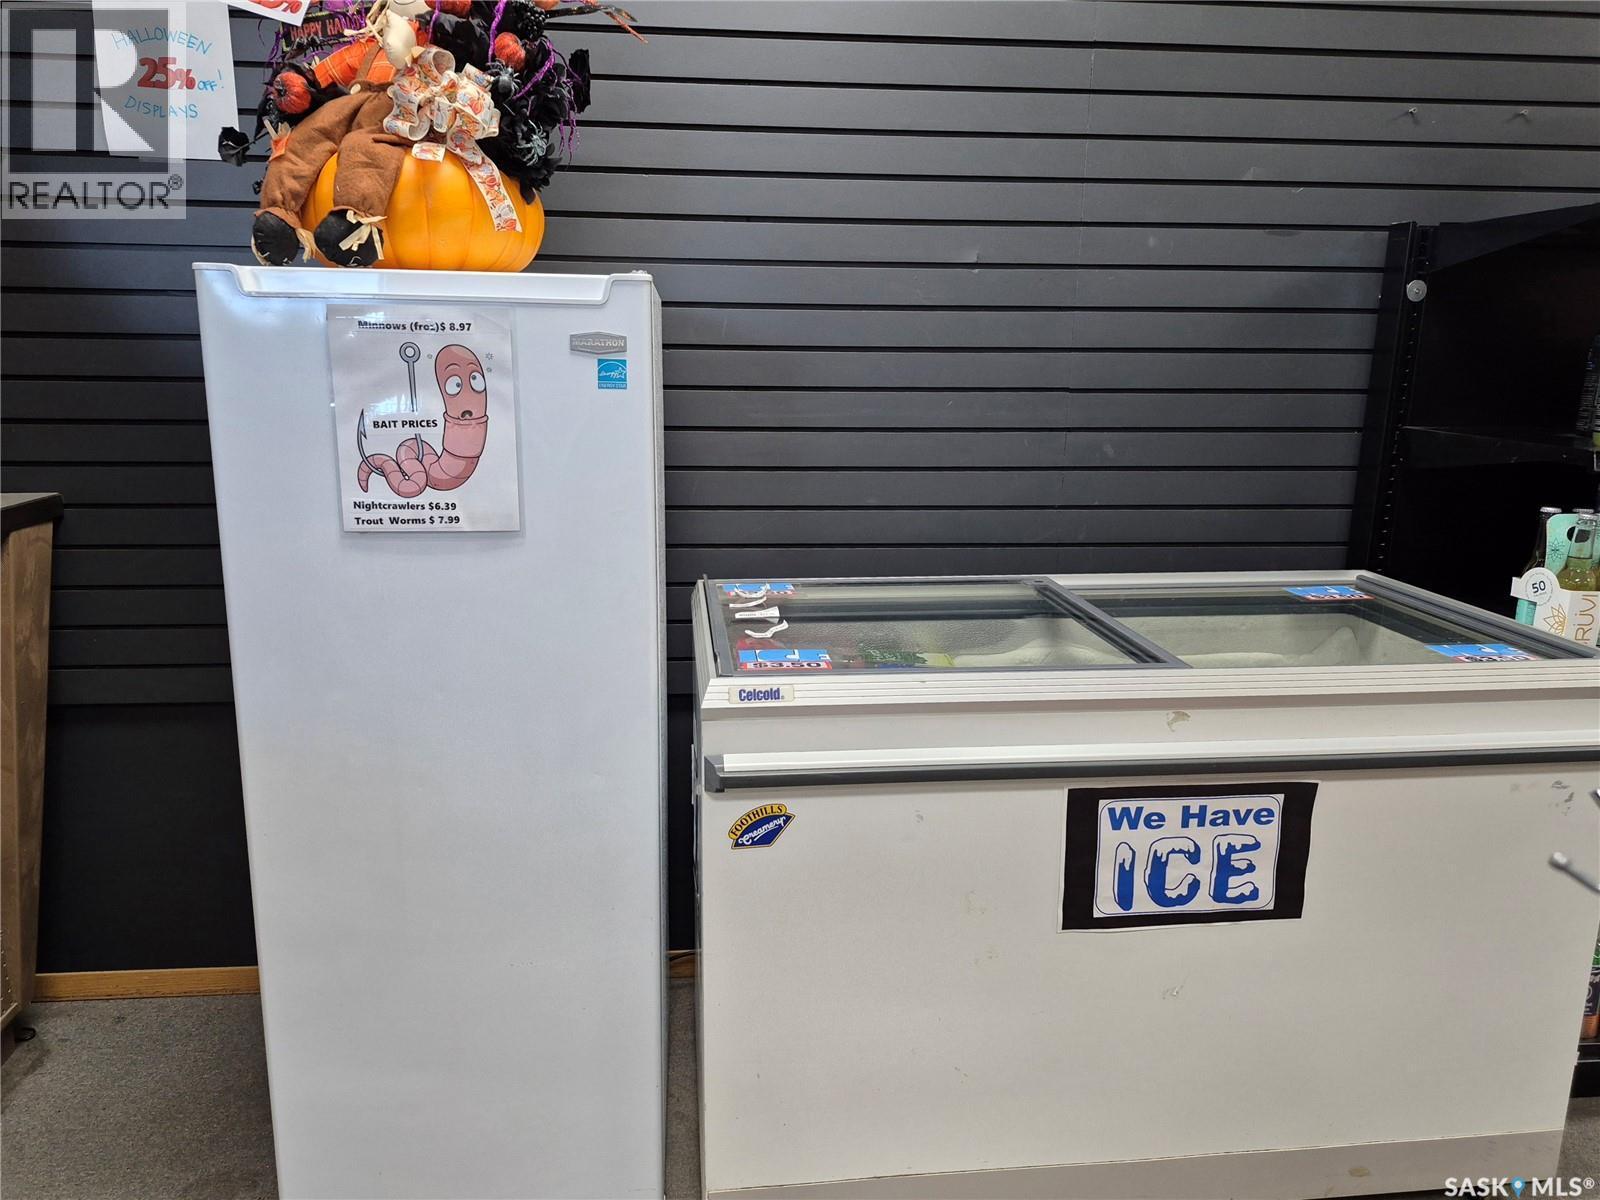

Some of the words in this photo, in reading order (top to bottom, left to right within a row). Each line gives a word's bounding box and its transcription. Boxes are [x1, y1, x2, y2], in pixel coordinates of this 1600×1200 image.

[112, 27, 213, 55] HALLOWEEN
[290, 19, 322, 40] HAPPY
[137, 57, 196, 90] 25%
[124, 96, 198, 119] DISPLAYS
[449, 322, 472, 331] 8.97
[373, 420, 399, 429] BAIT
[401, 419, 438, 428] PRICES
[353, 501, 426, 512] Nightcrawlers
[428, 502, 457, 511] $6.39
[354, 517, 384, 525] Trout
[389, 516, 427, 525] Worms
[438, 516, 461, 525] 7.99
[1532, 581, 1546, 593] 50
[731, 805, 783, 837] FOOTHILLS
[1107, 806, 1166, 831] We
[1181, 805, 1275, 829] Have
[738, 816, 786, 845] Creamery
[1112, 833, 1261, 911] ICE
